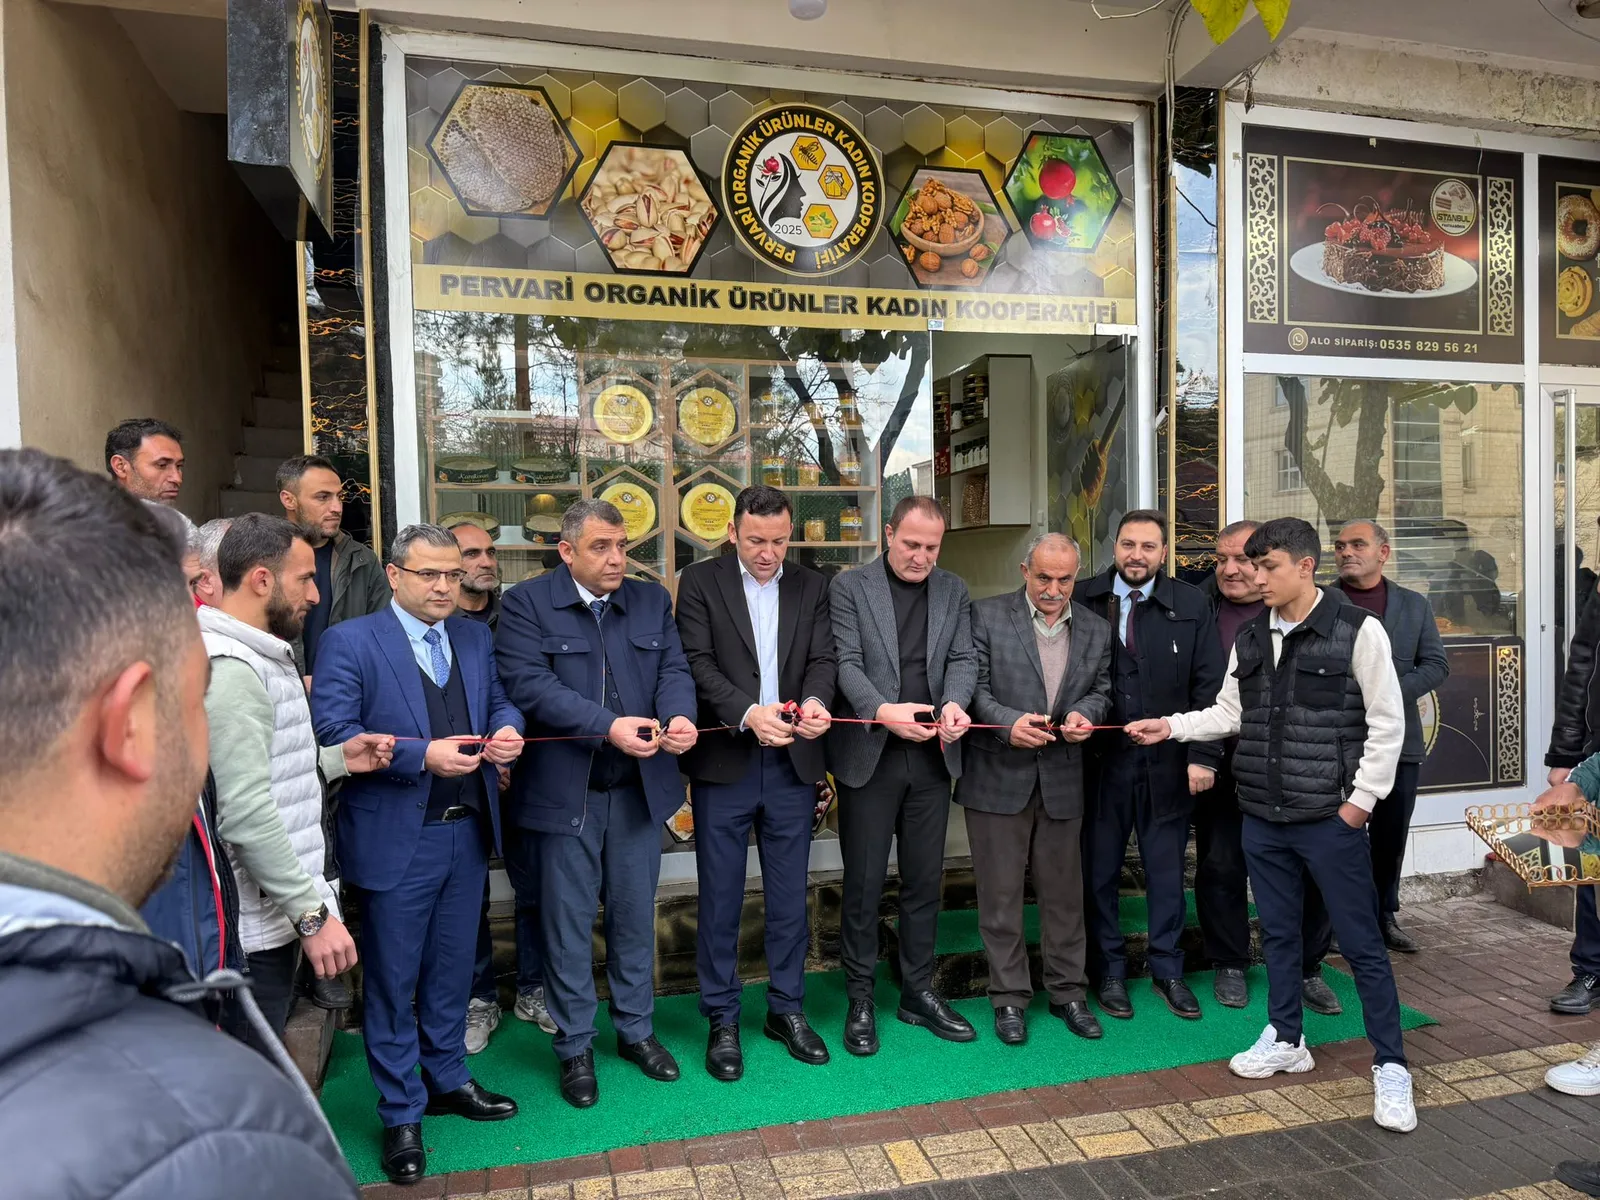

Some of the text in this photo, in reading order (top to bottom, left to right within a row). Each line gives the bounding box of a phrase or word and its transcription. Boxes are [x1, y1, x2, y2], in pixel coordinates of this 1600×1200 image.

[732, 111, 875, 270] PERVARİ ORGANİK ÜRÜNLER KADIN KOOPERATİFİ
[774, 223, 802, 235] 2025
[439, 273, 1118, 324] PERVARİ ORGANİK ÜRÜNLER KADIN KOOPERATİFİ
[1310, 335, 1478, 354] ALO SİPARİŞ: 0535 829 56 21
